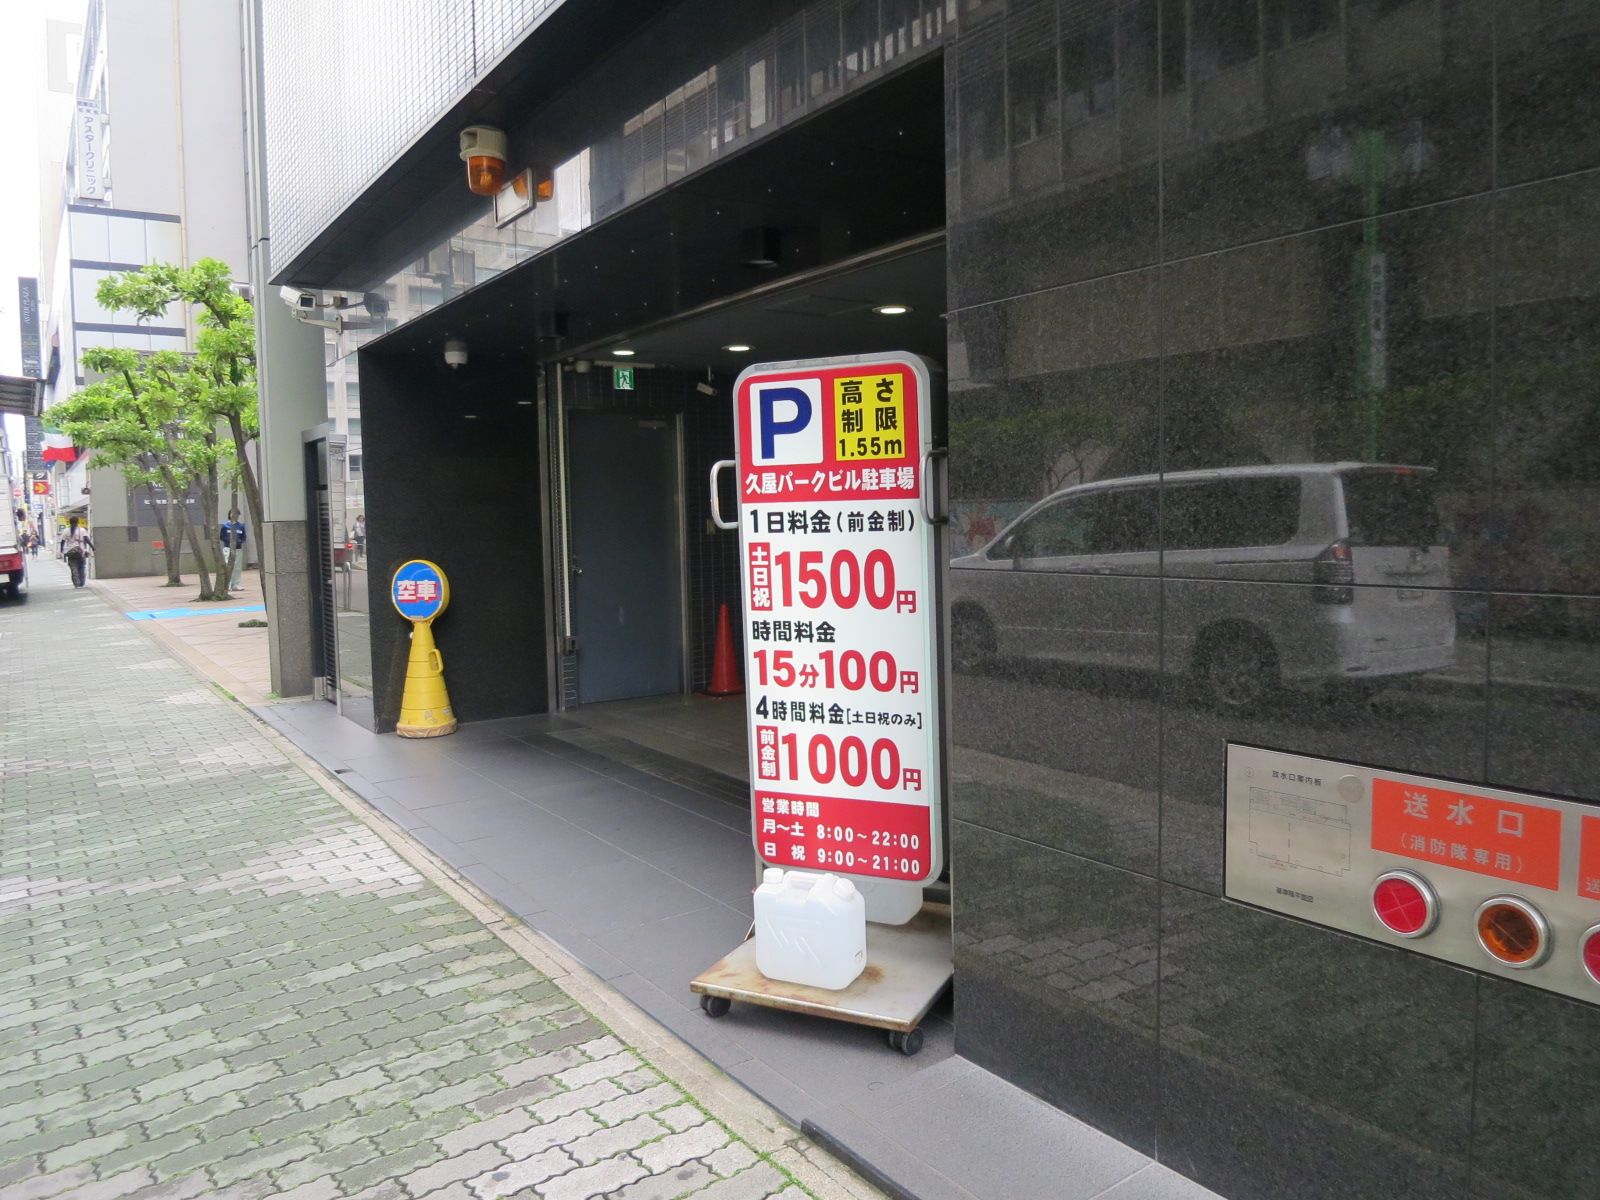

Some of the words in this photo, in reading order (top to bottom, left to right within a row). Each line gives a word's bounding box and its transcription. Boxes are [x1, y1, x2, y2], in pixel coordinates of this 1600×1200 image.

[83, 116, 97, 195] アスタークリニック
[840, 378, 894, 406] 高さ
[759, 387, 813, 460] P
[841, 407, 898, 433] 制限
[839, 437, 903, 457] 1.55m
[745, 466, 915, 495] 久屋パークビル駐車場
[397, 580, 438, 602] 空車
[751, 546, 771, 608] 土日祝
[775, 548, 917, 614] 1500円
[752, 620, 836, 643] 時間料金
[759, 728, 777, 777] 前金制
[781, 732, 922, 791] 1000円
[761, 797, 820, 818] 営業時間
[1403, 790, 1524, 838] 送水口
